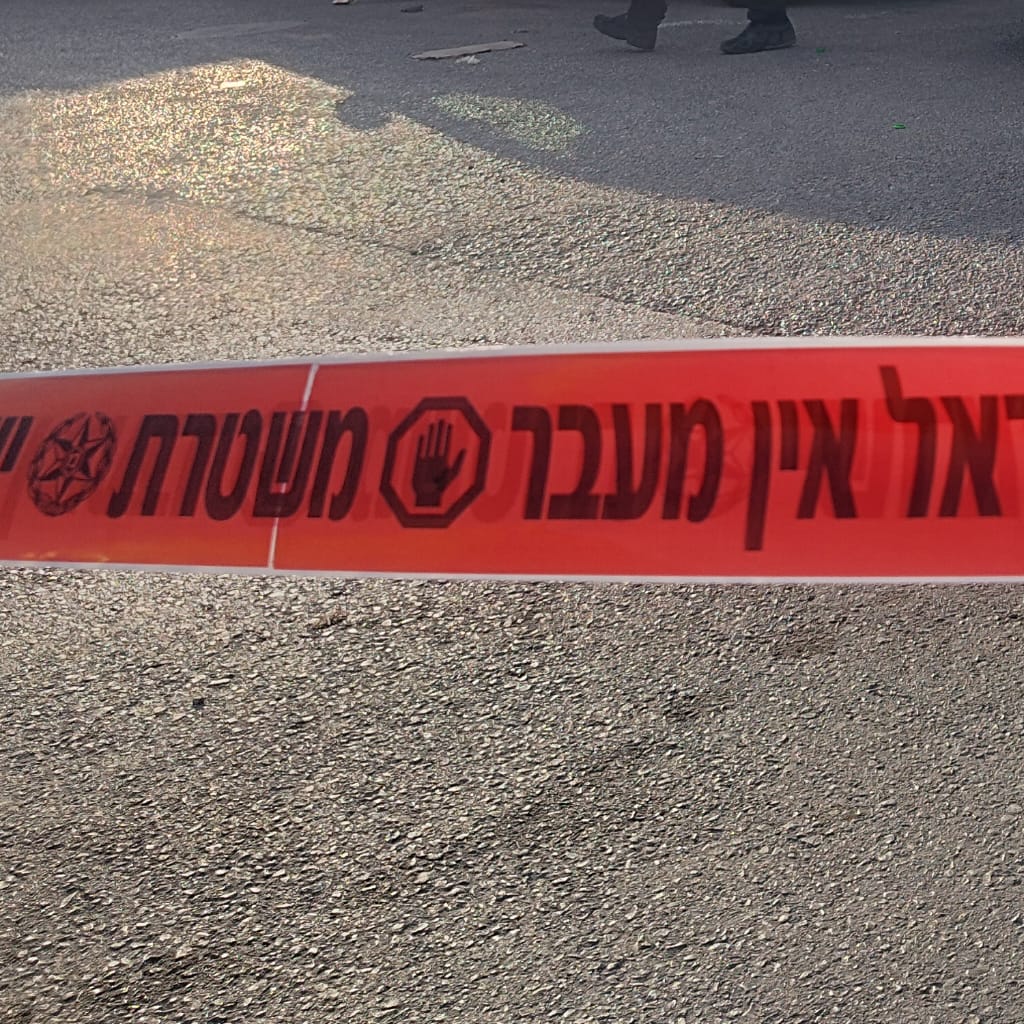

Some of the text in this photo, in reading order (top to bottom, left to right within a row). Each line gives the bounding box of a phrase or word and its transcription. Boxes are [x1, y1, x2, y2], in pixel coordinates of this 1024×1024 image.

[108, 407, 368, 521] משטרת
[511, 397, 723, 522] מעבר
[744, 398, 859, 551] אין
